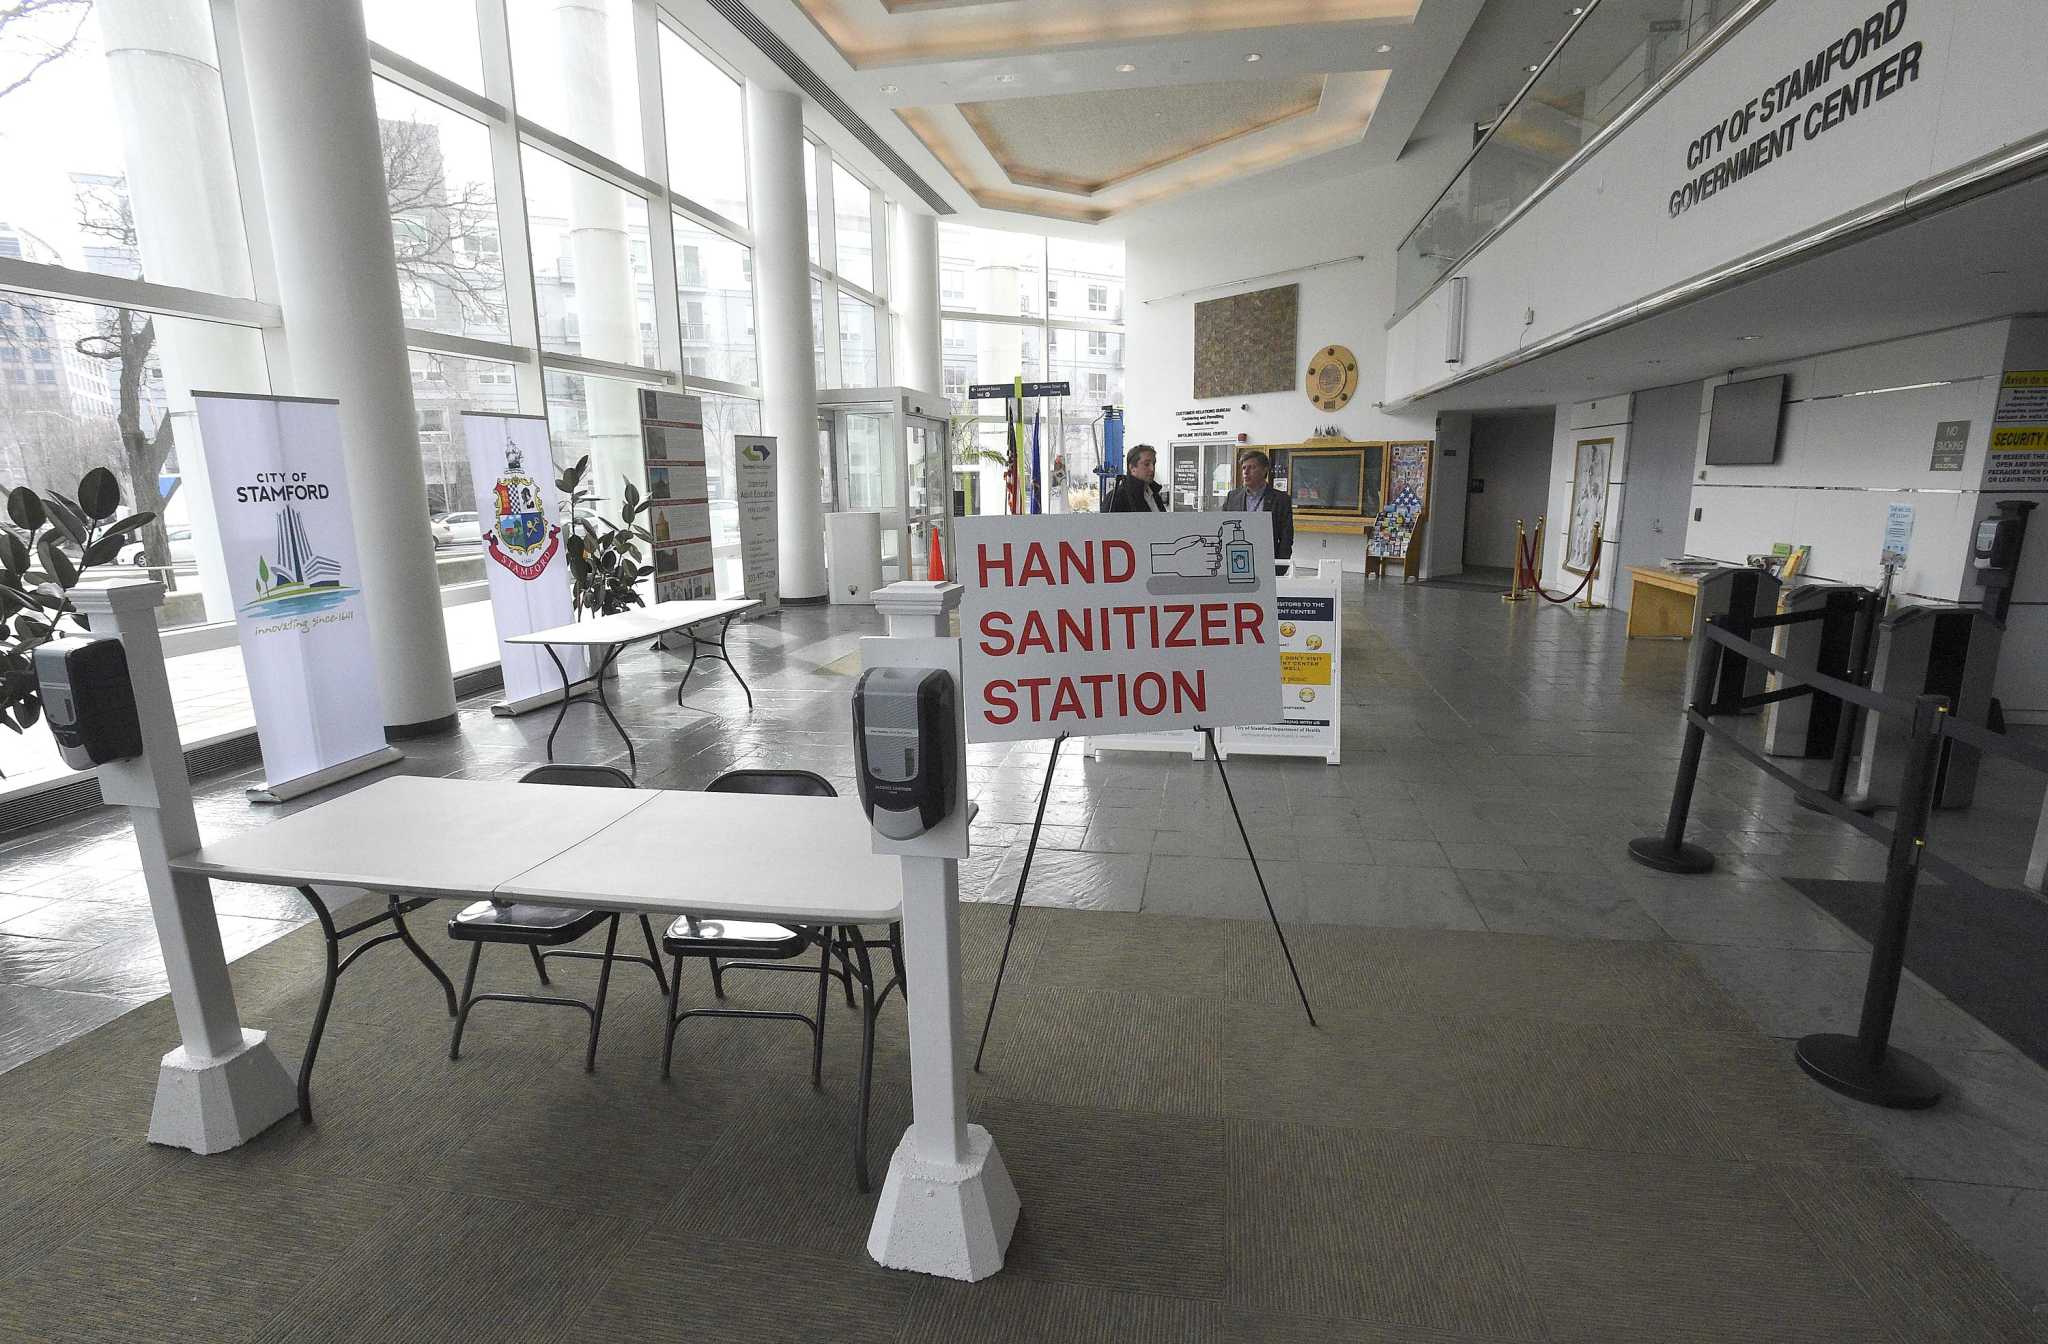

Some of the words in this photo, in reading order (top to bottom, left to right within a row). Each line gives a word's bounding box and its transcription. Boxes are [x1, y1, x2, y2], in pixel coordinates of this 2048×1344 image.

[1687, 119, 1728, 170] CITY
[1729, 98, 1758, 143] OF
[1760, 0, 1908, 122] STAMFORD
[1668, 114, 1801, 219] GOVERNMENT
[1803, 40, 1923, 140] CENTER
[1944, 426, 1959, 437] NO
[1994, 431, 2044, 447] SECURITY
[256, 472, 287, 483] CITY
[292, 472, 308, 482] OF
[236, 484, 329, 502] STAMFORD
[501, 551, 550, 576] STAMFORD
[977, 540, 1136, 588] HAND
[255, 618, 310, 636] innovating
[979, 602, 1265, 657] SANITIZER
[983, 670, 1207, 725] STATION
